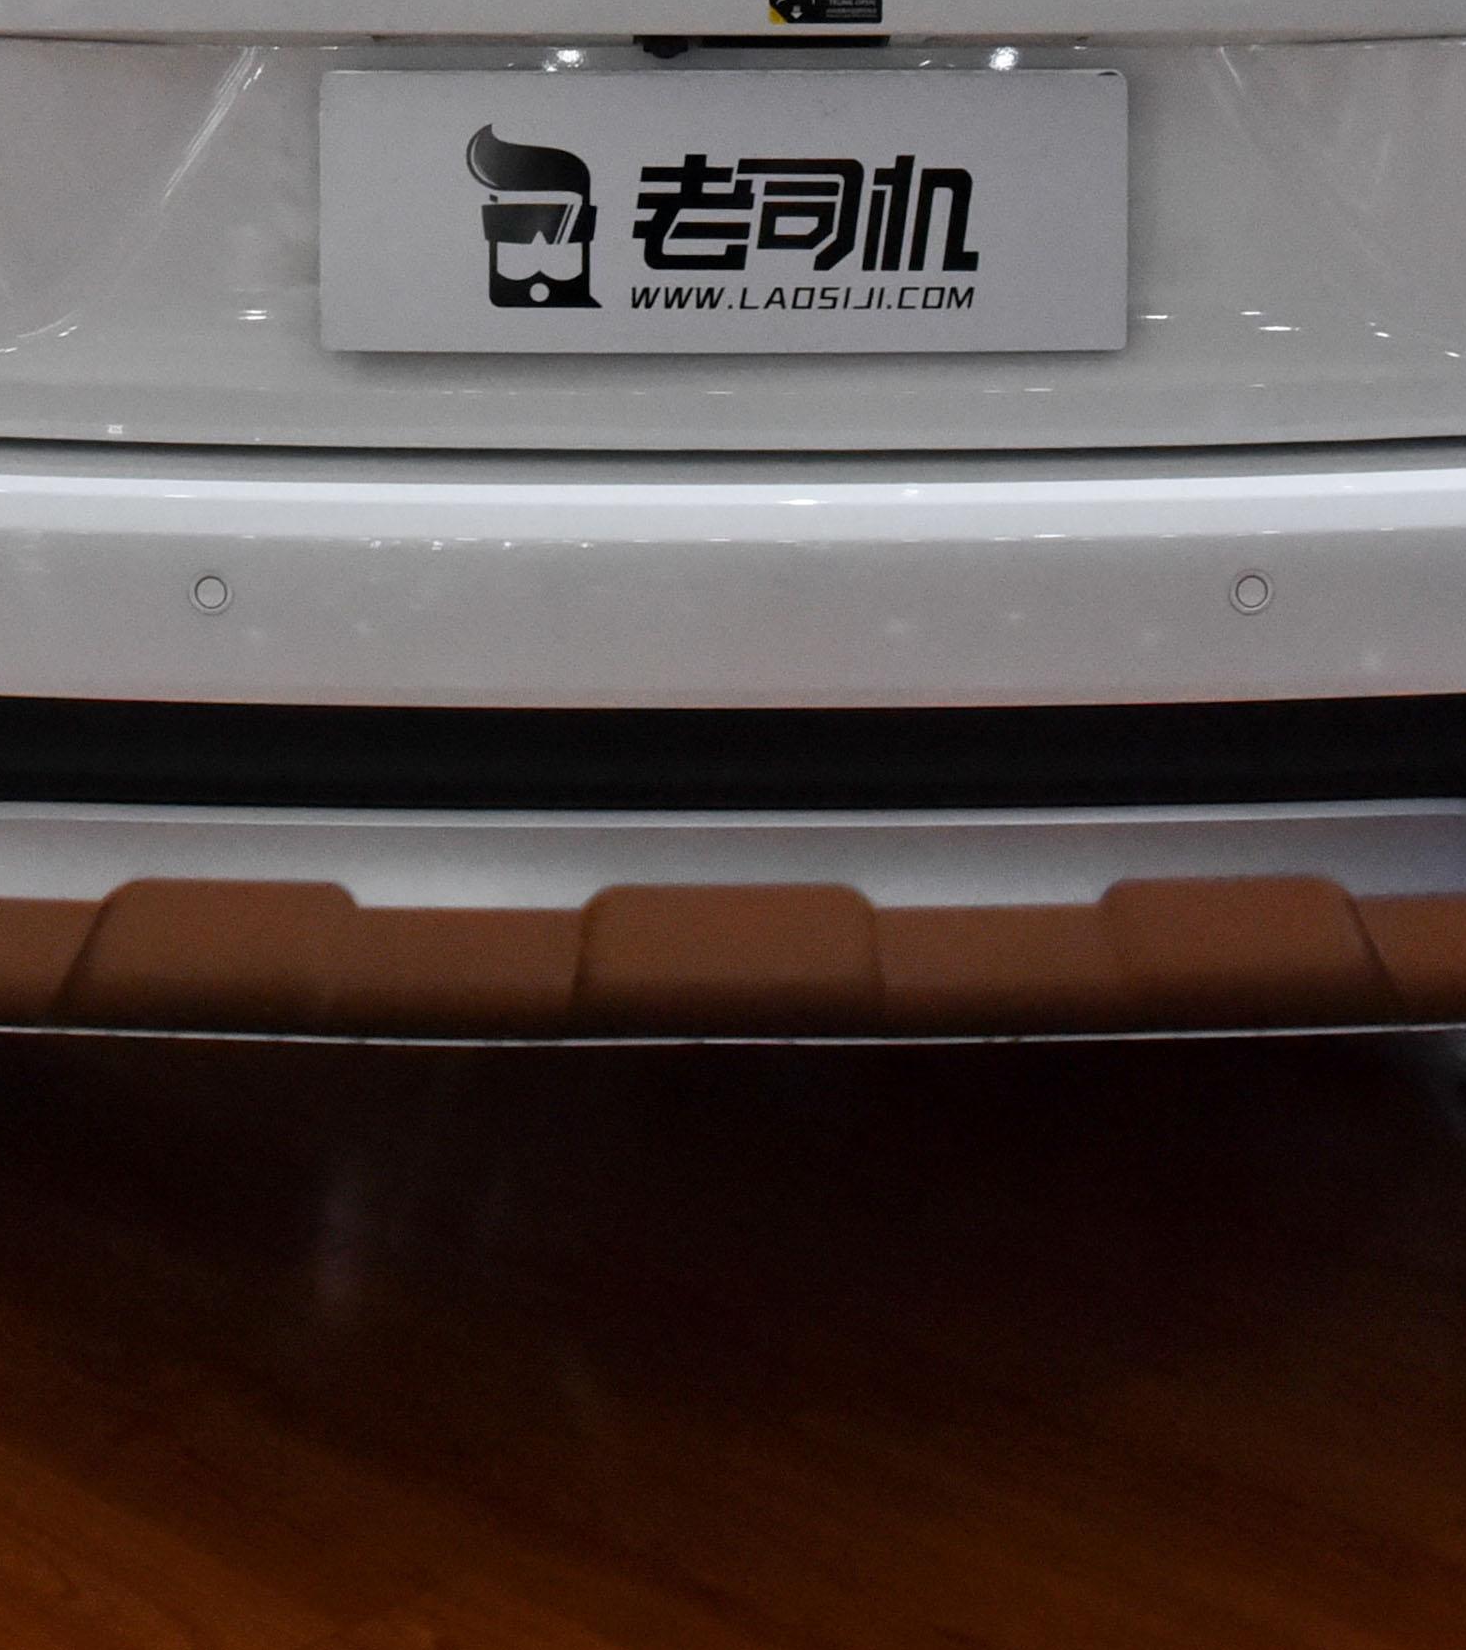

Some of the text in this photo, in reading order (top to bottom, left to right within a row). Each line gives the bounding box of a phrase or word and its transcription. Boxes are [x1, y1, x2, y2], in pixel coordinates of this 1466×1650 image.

[632, 153, 980, 272] 老司机
[631, 285, 976, 311] WWW.LAOSIJI.COM
